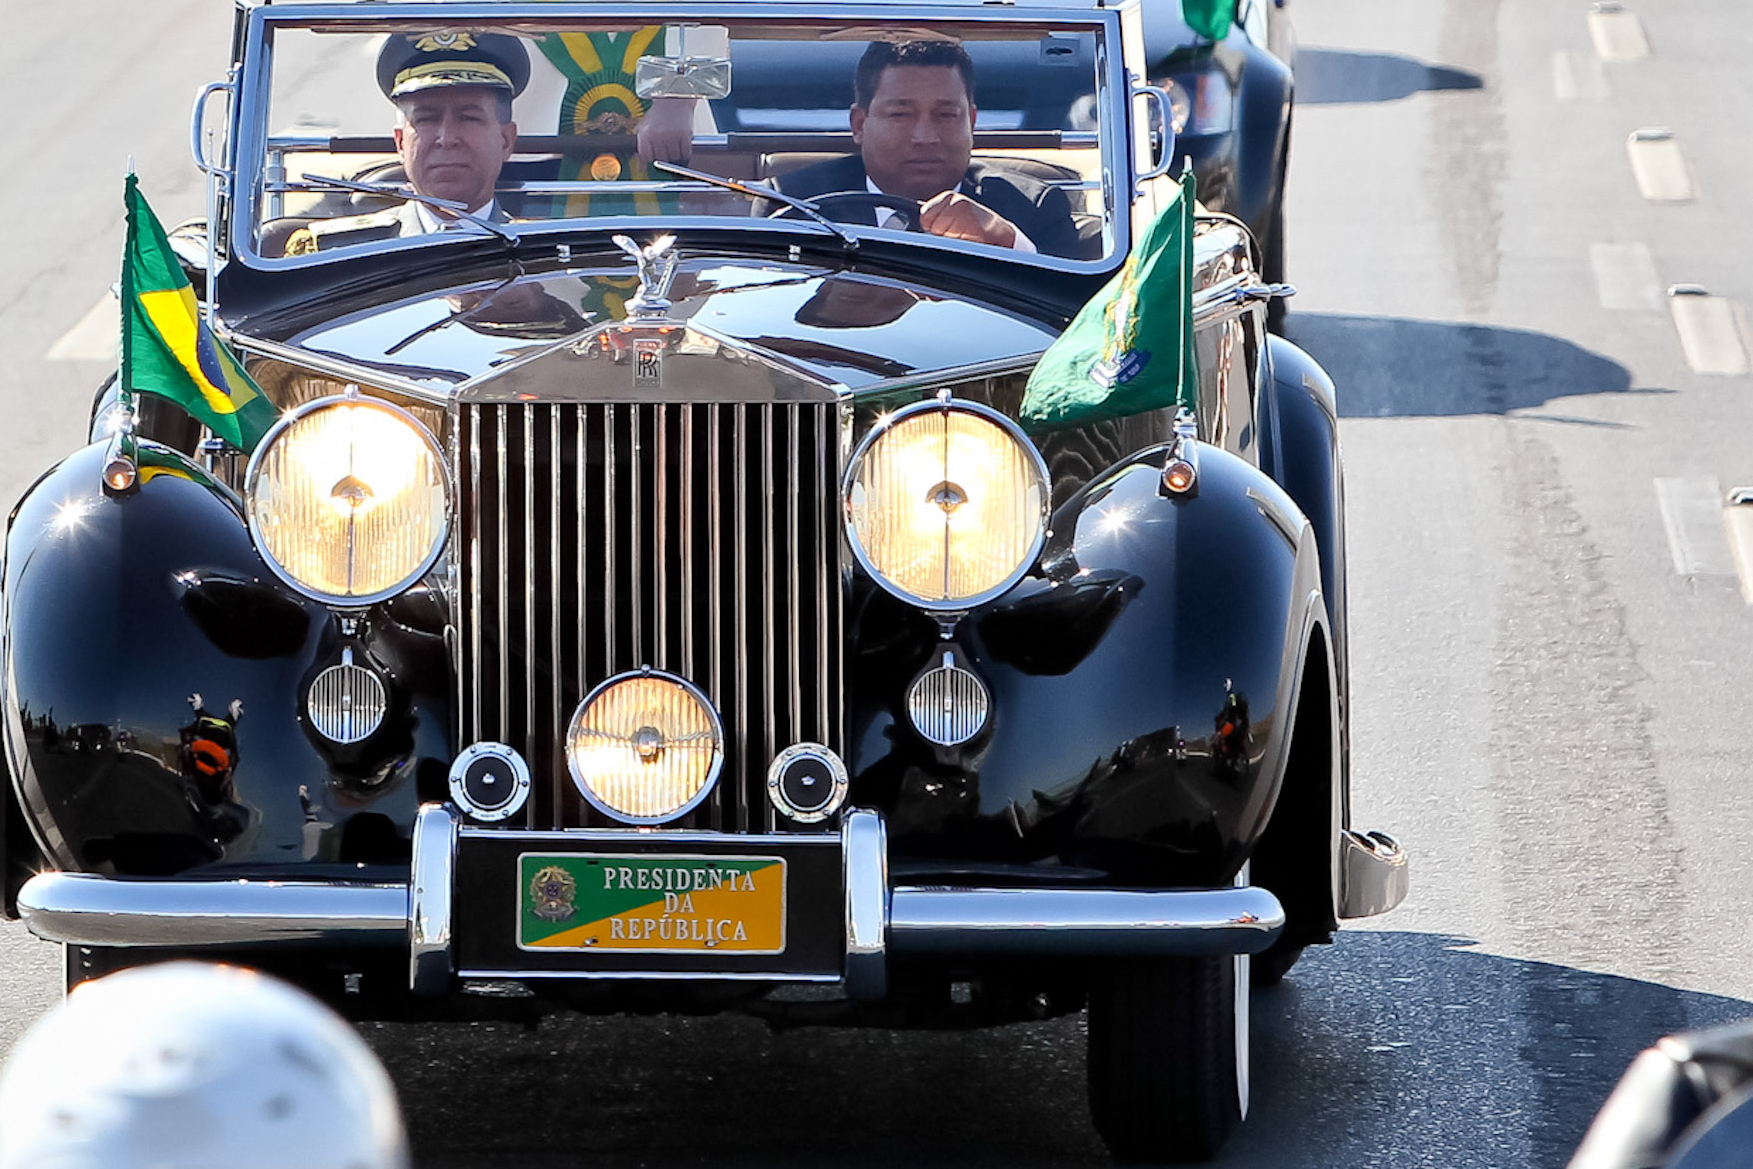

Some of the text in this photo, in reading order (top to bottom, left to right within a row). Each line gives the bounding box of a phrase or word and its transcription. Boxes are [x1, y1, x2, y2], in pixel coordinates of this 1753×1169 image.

[603, 867, 756, 892] PRESIDENTA
[664, 893, 695, 913] DA
[610, 915, 748, 941] REPÚBLICA
